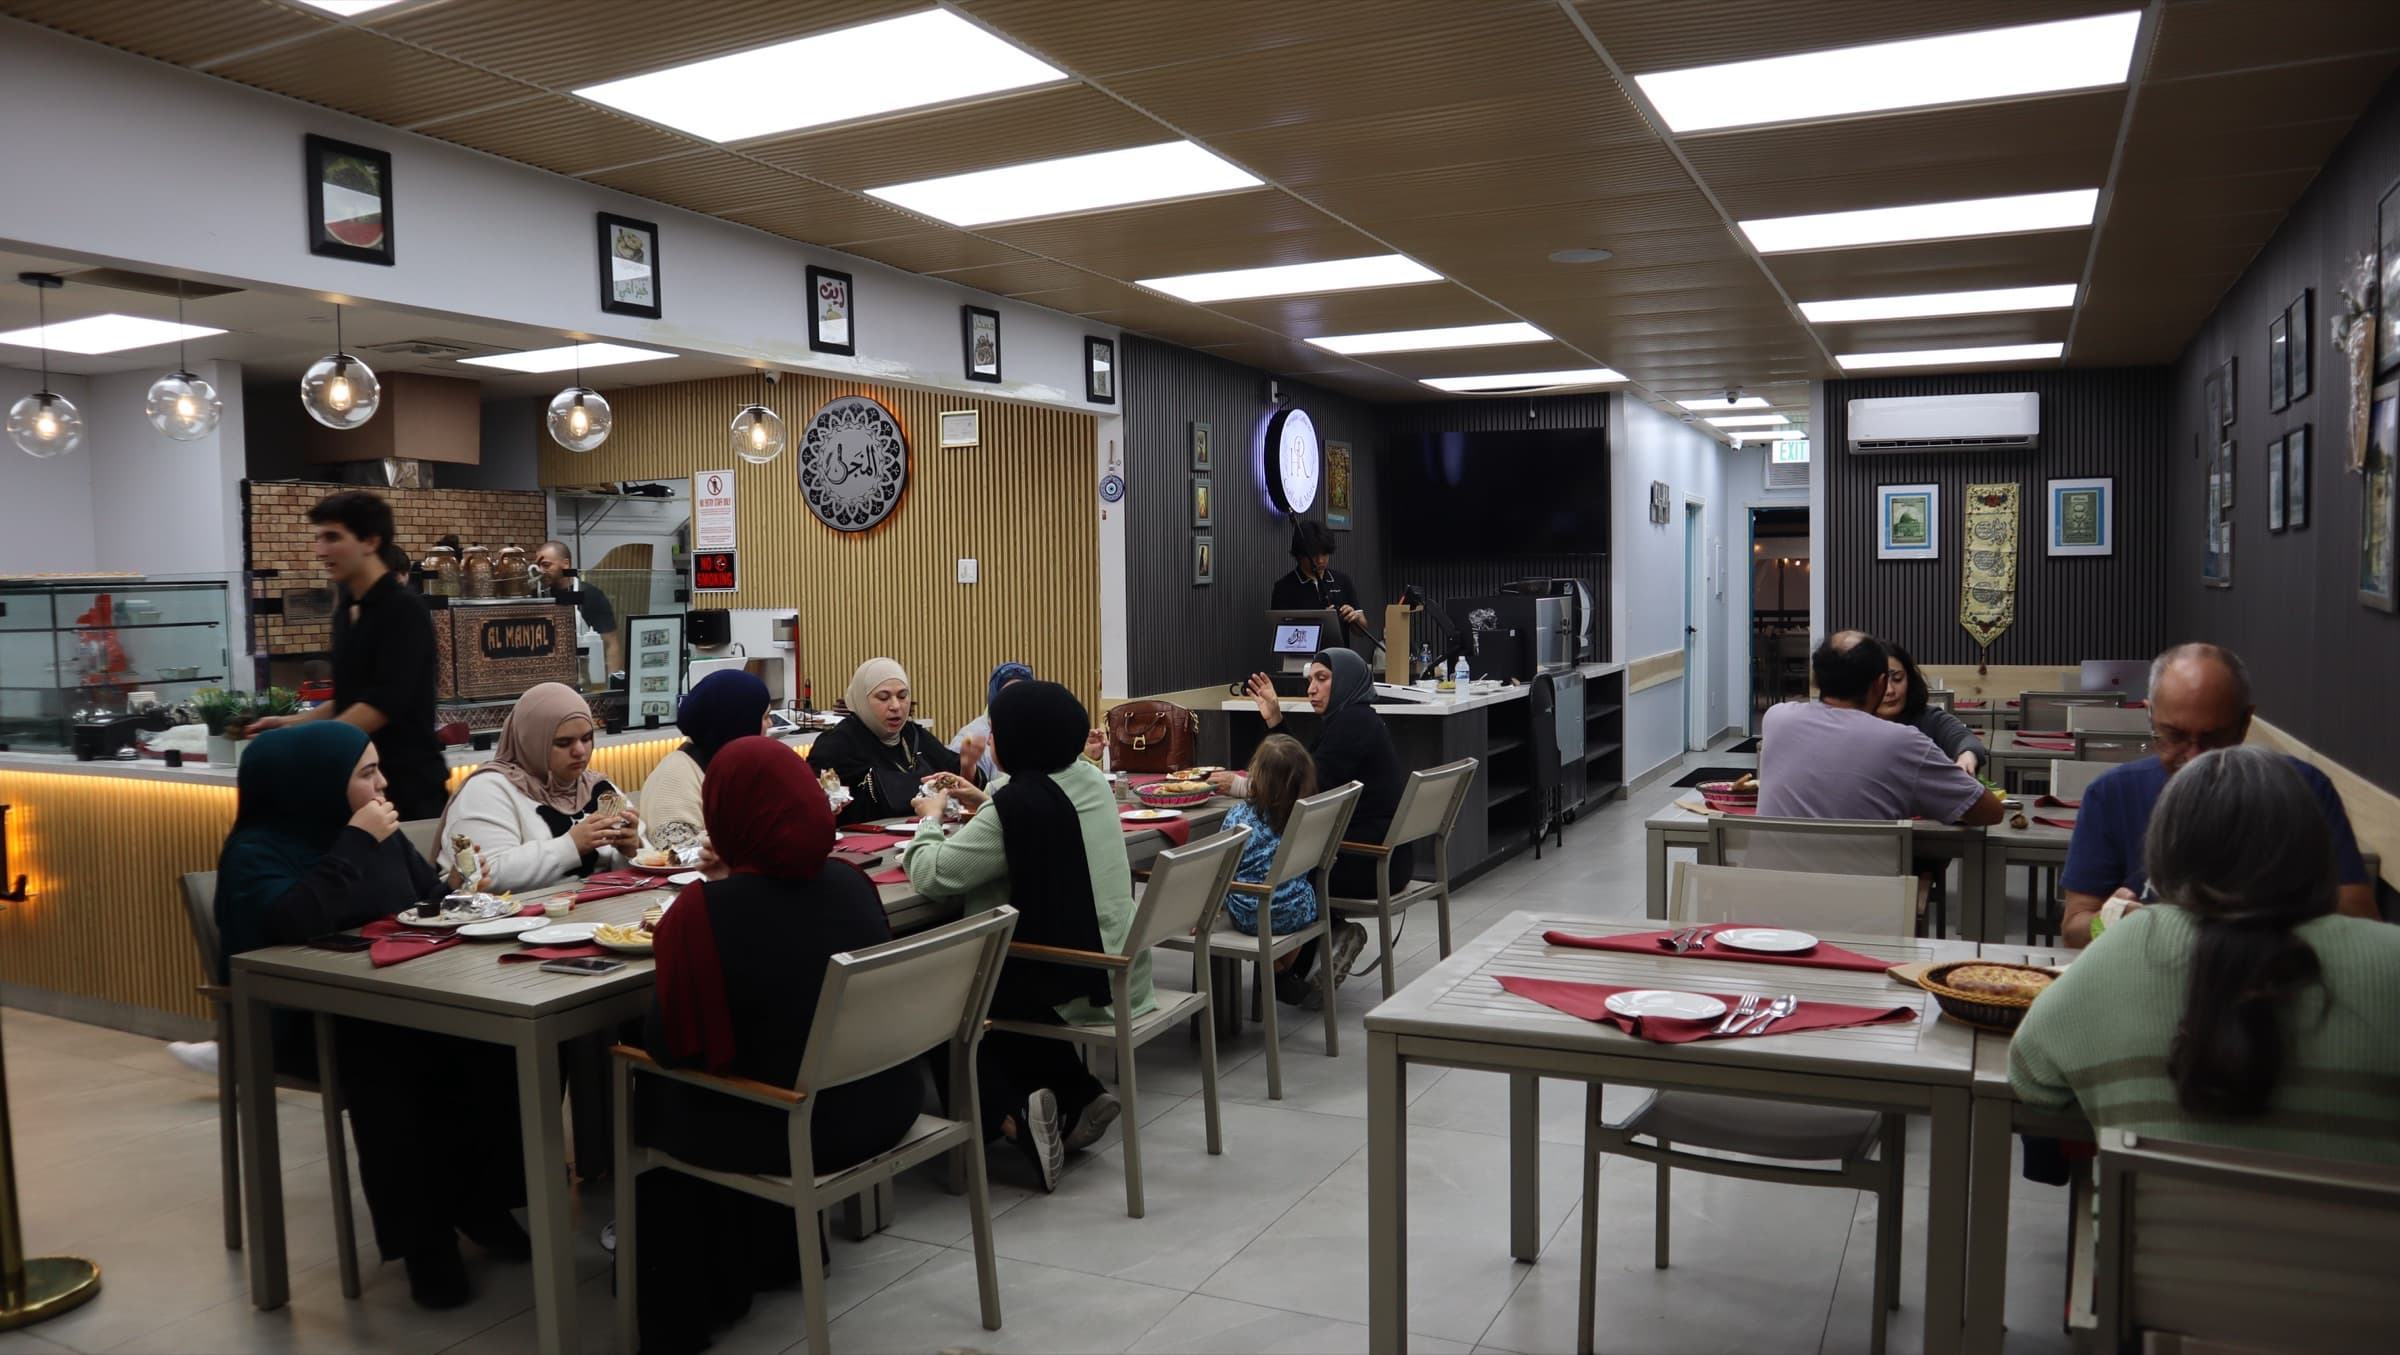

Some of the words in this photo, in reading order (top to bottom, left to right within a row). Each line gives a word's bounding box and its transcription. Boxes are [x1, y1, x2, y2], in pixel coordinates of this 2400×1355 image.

[820, 281, 845, 308] زيت
[1780, 441, 1806, 461] EXIT
[700, 555, 712, 570] NO
[697, 572, 733, 588] SMOKING
[488, 626, 502, 650] AL
[505, 624, 549, 651] MANJAL
